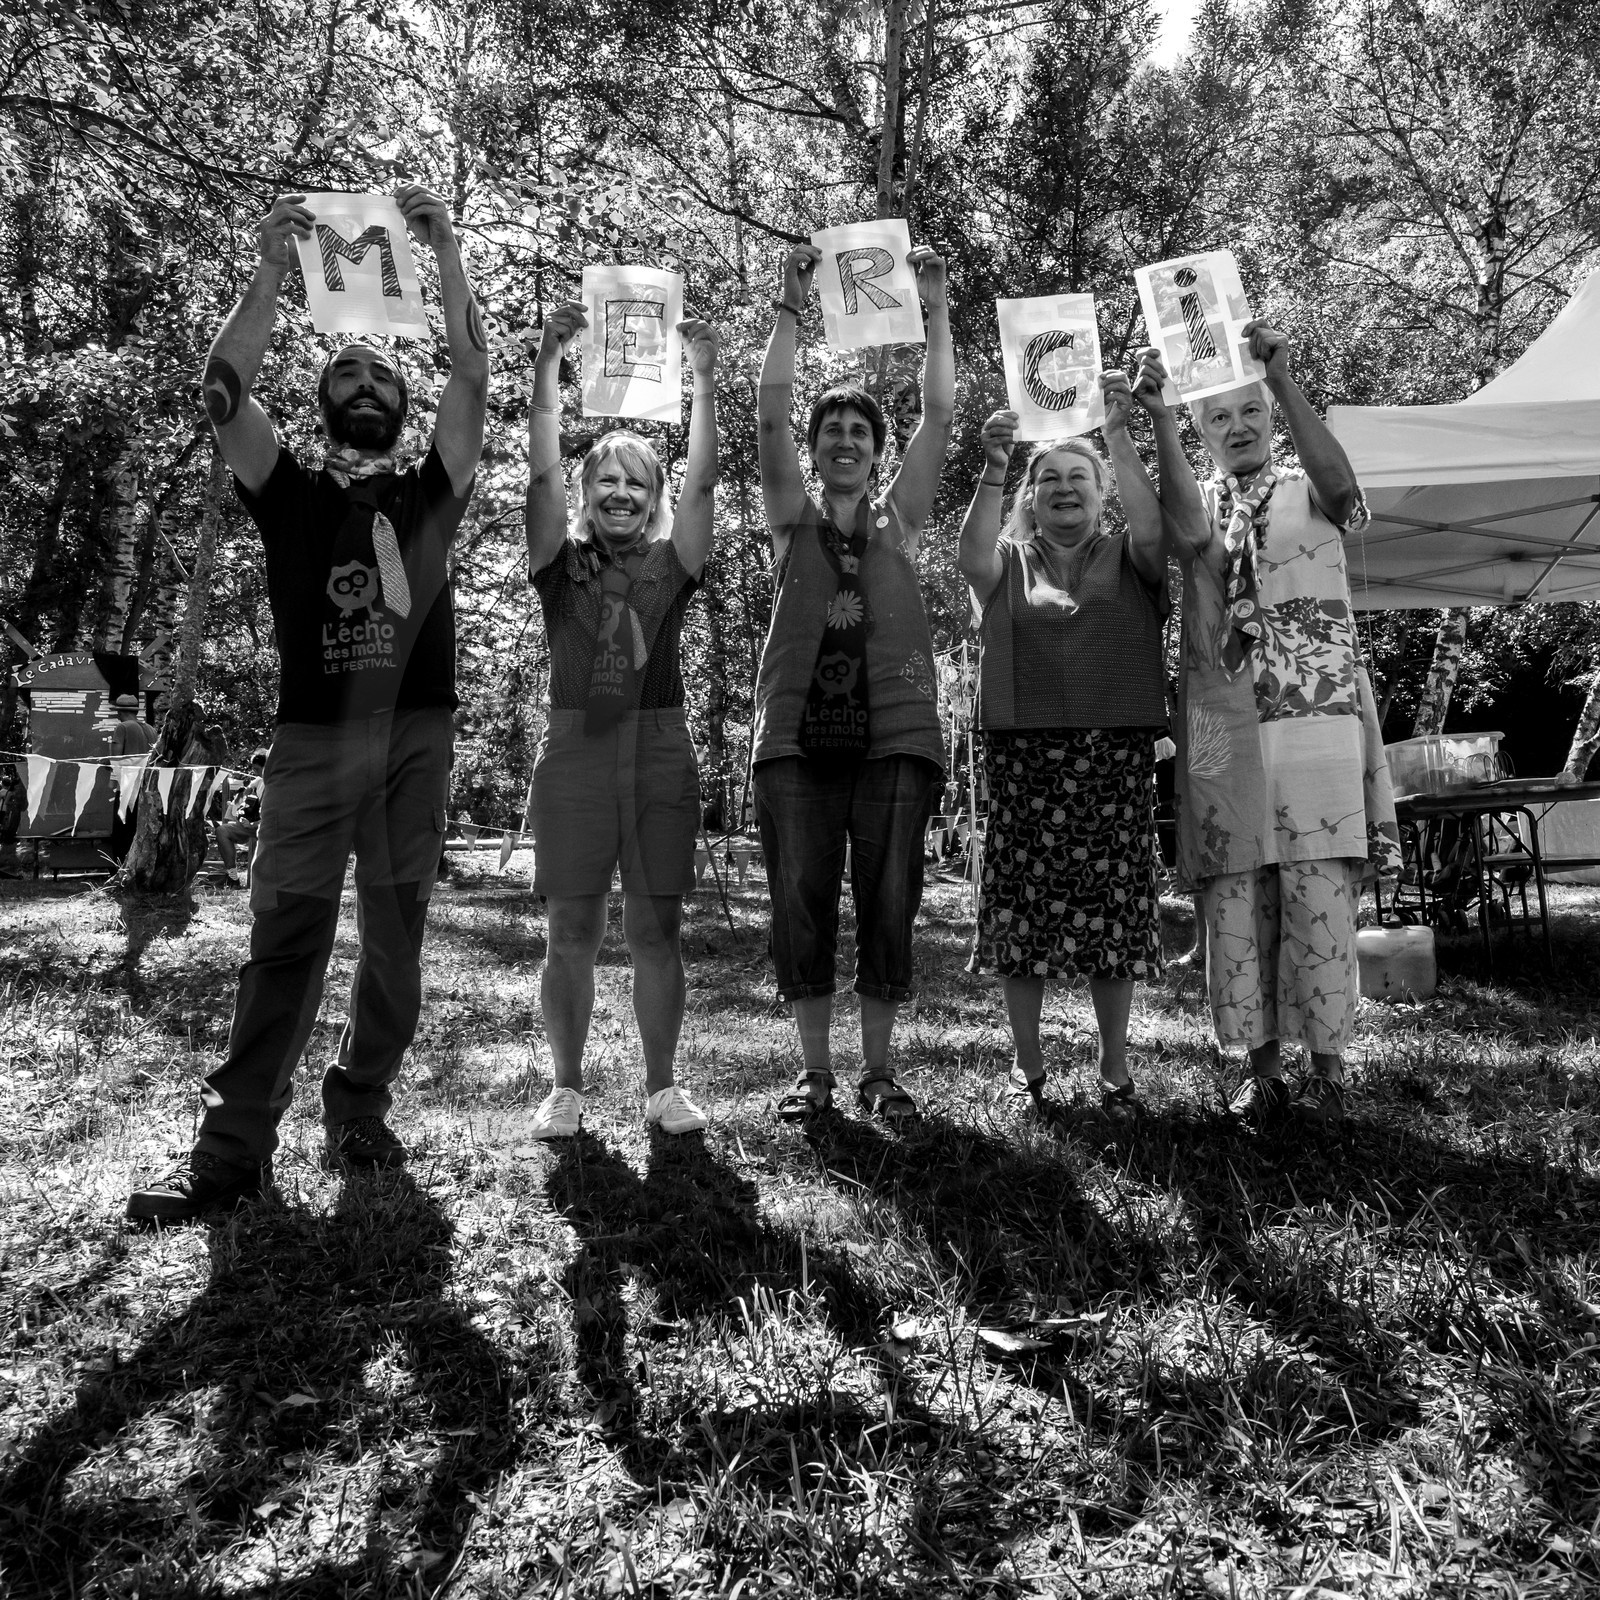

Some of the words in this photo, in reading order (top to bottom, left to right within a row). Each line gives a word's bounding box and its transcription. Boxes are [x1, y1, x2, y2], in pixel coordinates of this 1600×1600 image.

[315, 224, 402, 300] M
[836, 247, 903, 316] R
[1174, 267, 1216, 361] i
[604, 298, 665, 383] E
[1023, 330, 1076, 411] C
[322, 620, 395, 646] L'écho
[324, 646, 349, 660] des
[352, 639, 393, 657] mots
[324, 663, 339, 674] LE
[342, 657, 397, 672] FESTIVAL
[11, 669, 35, 687] Le
[591, 669, 624, 685] mots
[805, 703, 868, 723] L'écho
[805, 723, 827, 735] des
[829, 723, 865, 736] mots
[805, 737, 817, 748] LE
[820, 737, 867, 748] FESTIVAL
